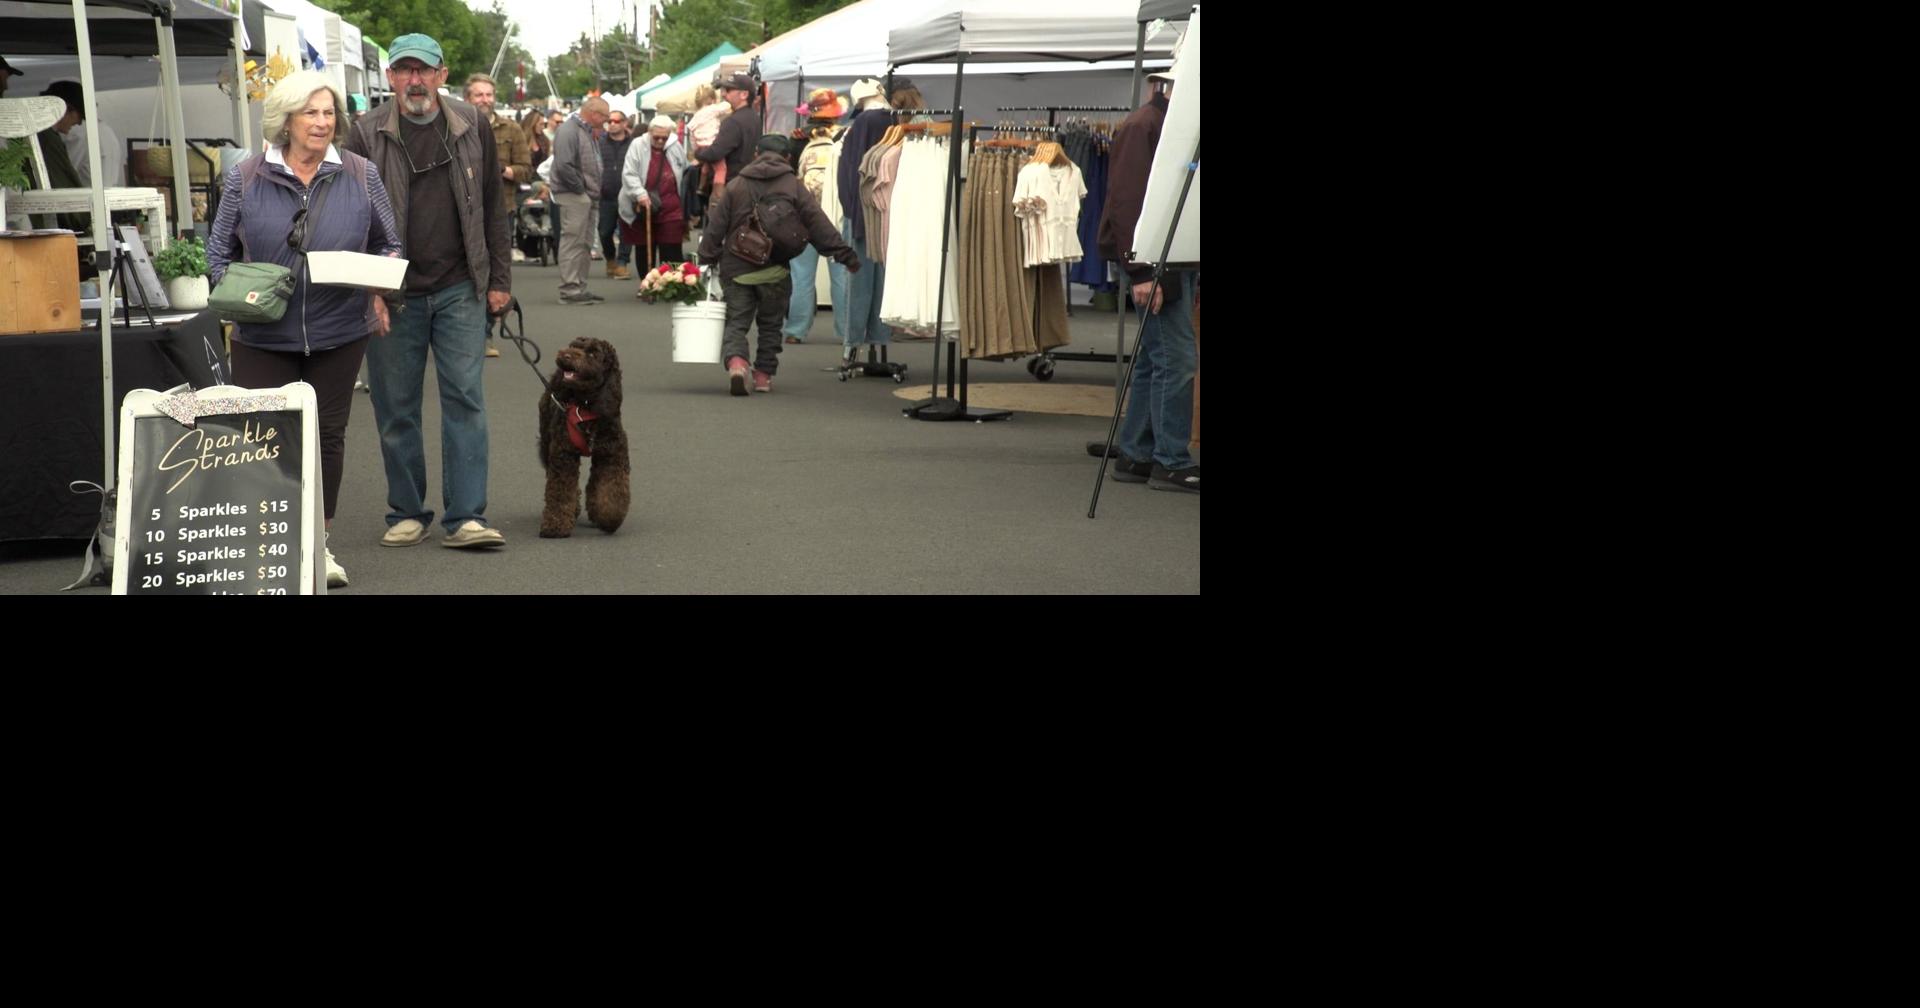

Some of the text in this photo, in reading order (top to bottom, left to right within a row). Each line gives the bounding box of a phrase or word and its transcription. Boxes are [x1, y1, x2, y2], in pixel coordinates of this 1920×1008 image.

[159, 420, 278, 494] Sparkle
[151, 500, 288, 521] 5 Sparkles $15
[145, 521, 288, 543] 10 Sparkles $30
[144, 543, 288, 565] 15 Sparkles $40
[142, 565, 287, 588] 20 Sparkles $50
